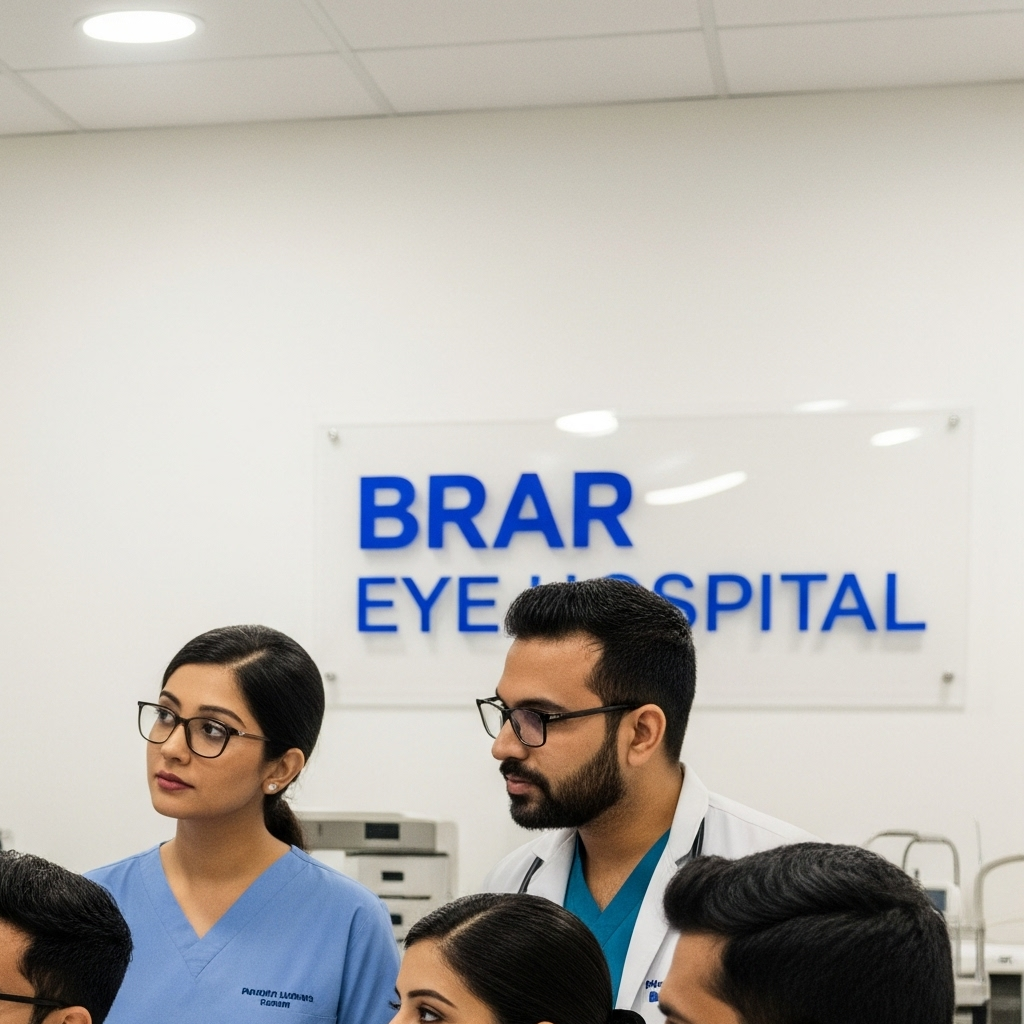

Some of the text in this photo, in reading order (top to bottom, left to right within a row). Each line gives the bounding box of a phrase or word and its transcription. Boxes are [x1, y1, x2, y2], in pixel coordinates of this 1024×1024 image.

[359, 471, 634, 551] BRAR
[357, 572, 928, 634] EYE SPITAL
